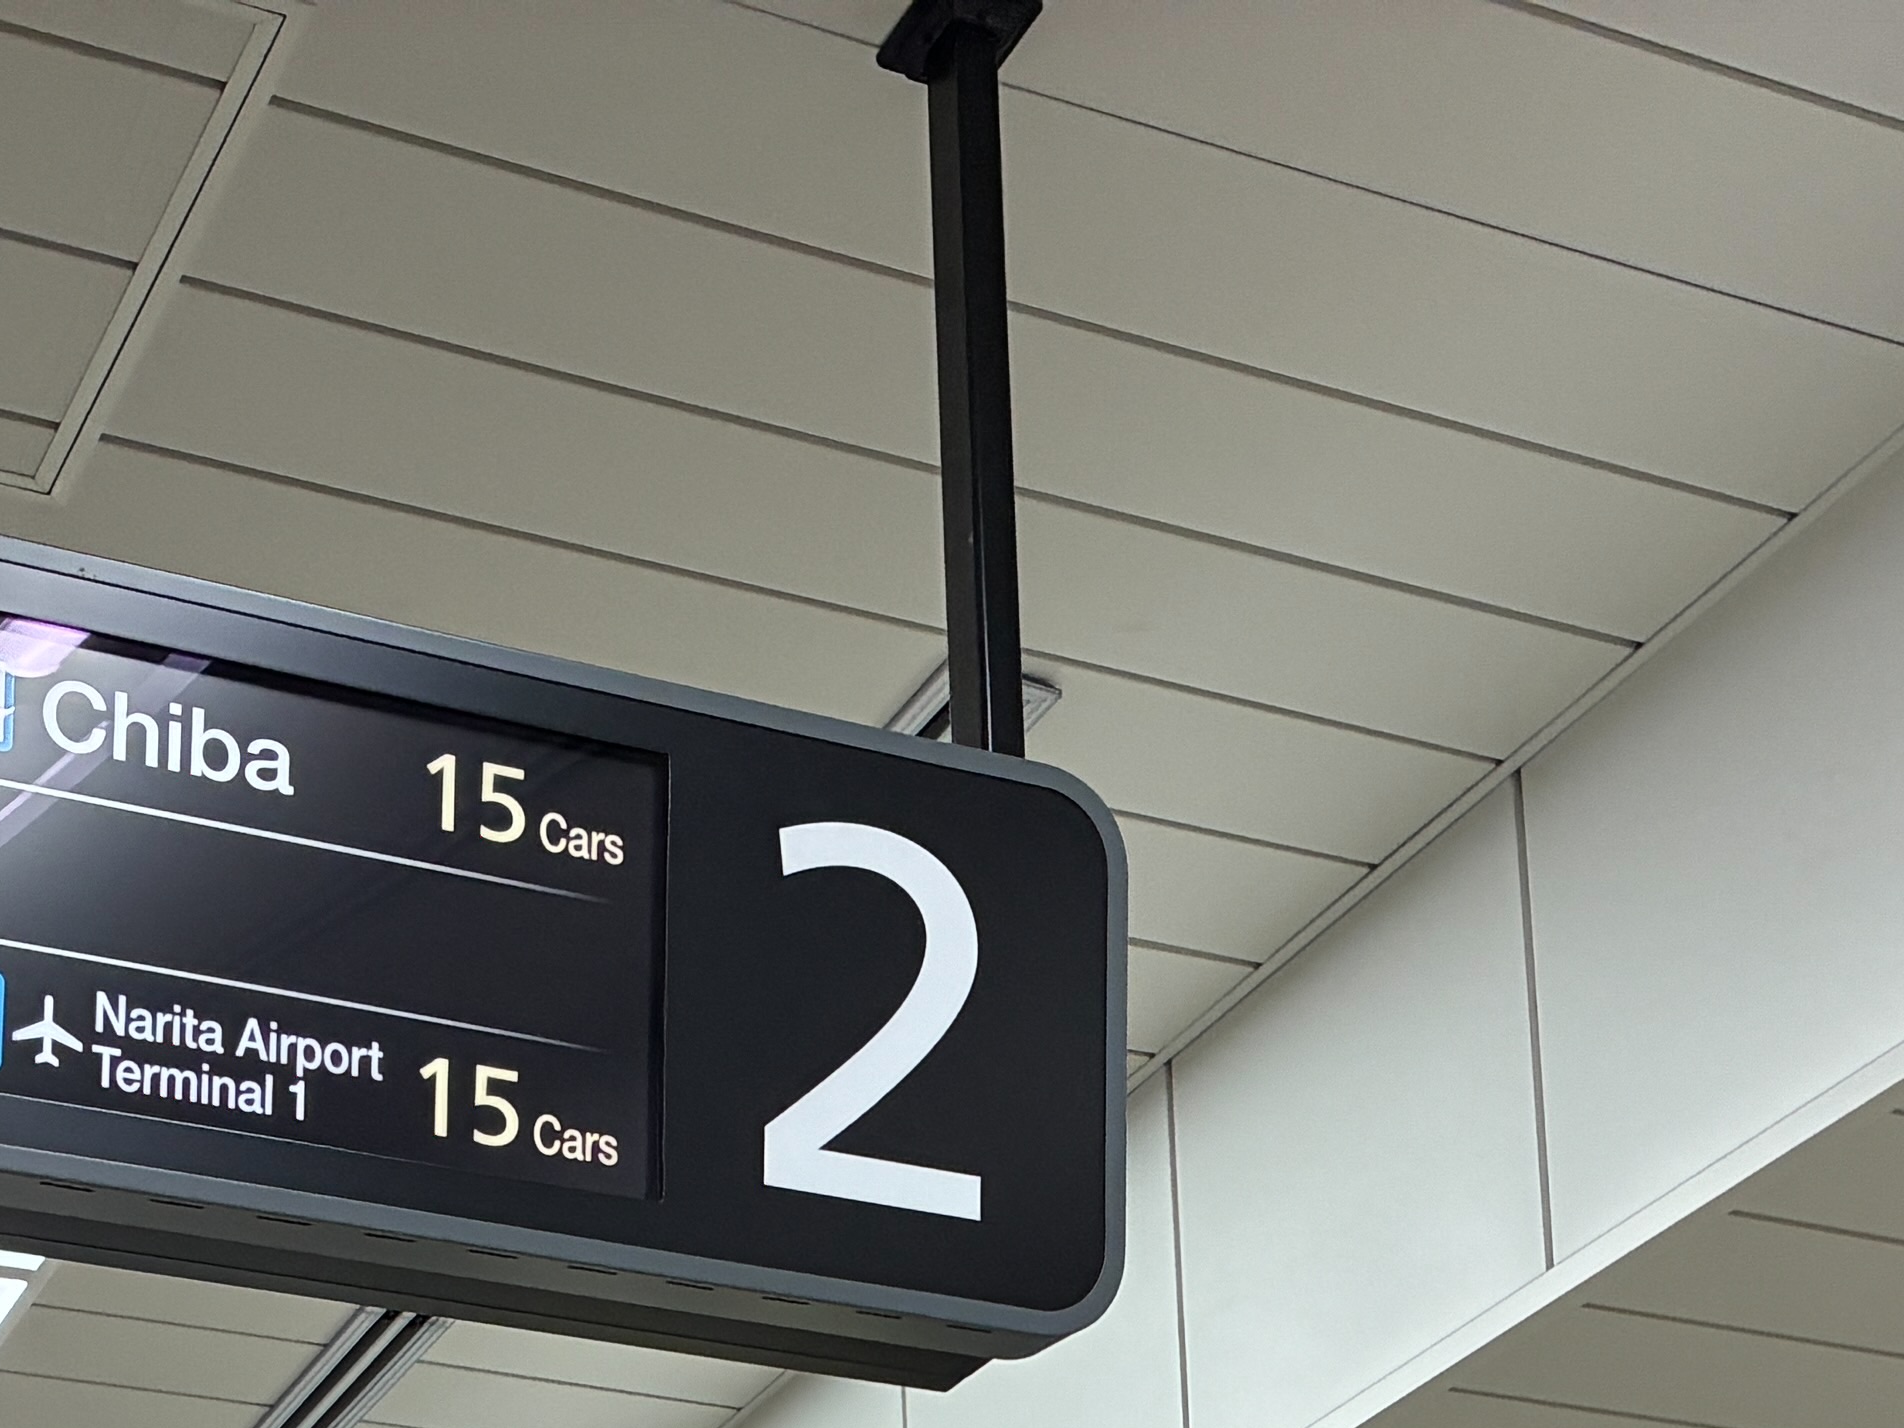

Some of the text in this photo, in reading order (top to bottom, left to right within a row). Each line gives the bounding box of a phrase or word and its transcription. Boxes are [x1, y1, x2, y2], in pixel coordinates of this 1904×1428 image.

[43, 681, 294, 796] Chiba
[426, 753, 624, 866] 15 Cars
[94, 992, 383, 1082] Narita Airport
[763, 821, 982, 1222] 2
[92, 1046, 306, 1121] Terminal 1
[420, 1058, 618, 1167] 15 Cars
